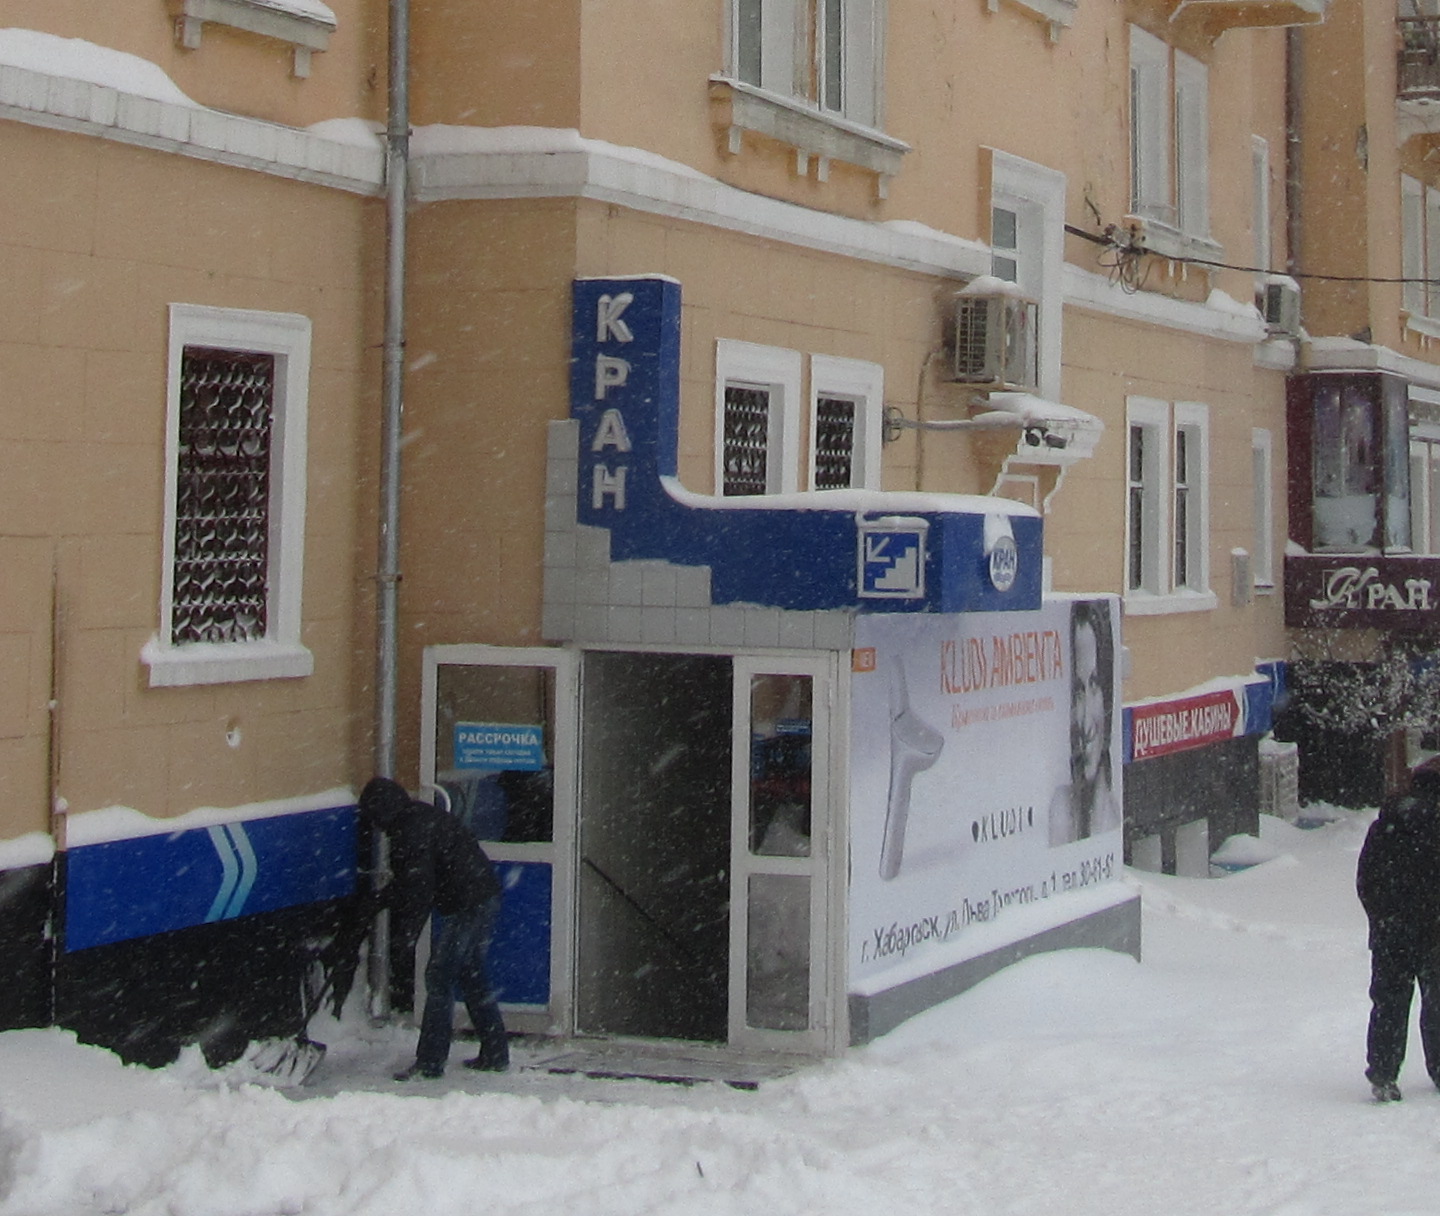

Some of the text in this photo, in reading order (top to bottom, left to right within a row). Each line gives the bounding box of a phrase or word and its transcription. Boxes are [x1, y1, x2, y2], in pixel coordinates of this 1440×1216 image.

[591, 292, 634, 510] КРАН
[940, 638, 987, 695] KLUDI
[458, 732, 538, 745] РАССРОЧКА
[1134, 702, 1232, 758] ДУШЕВЫЕ КАБИНЫ
[981, 805, 1023, 843] KLUDI
[962, 897, 990, 925] Льва
